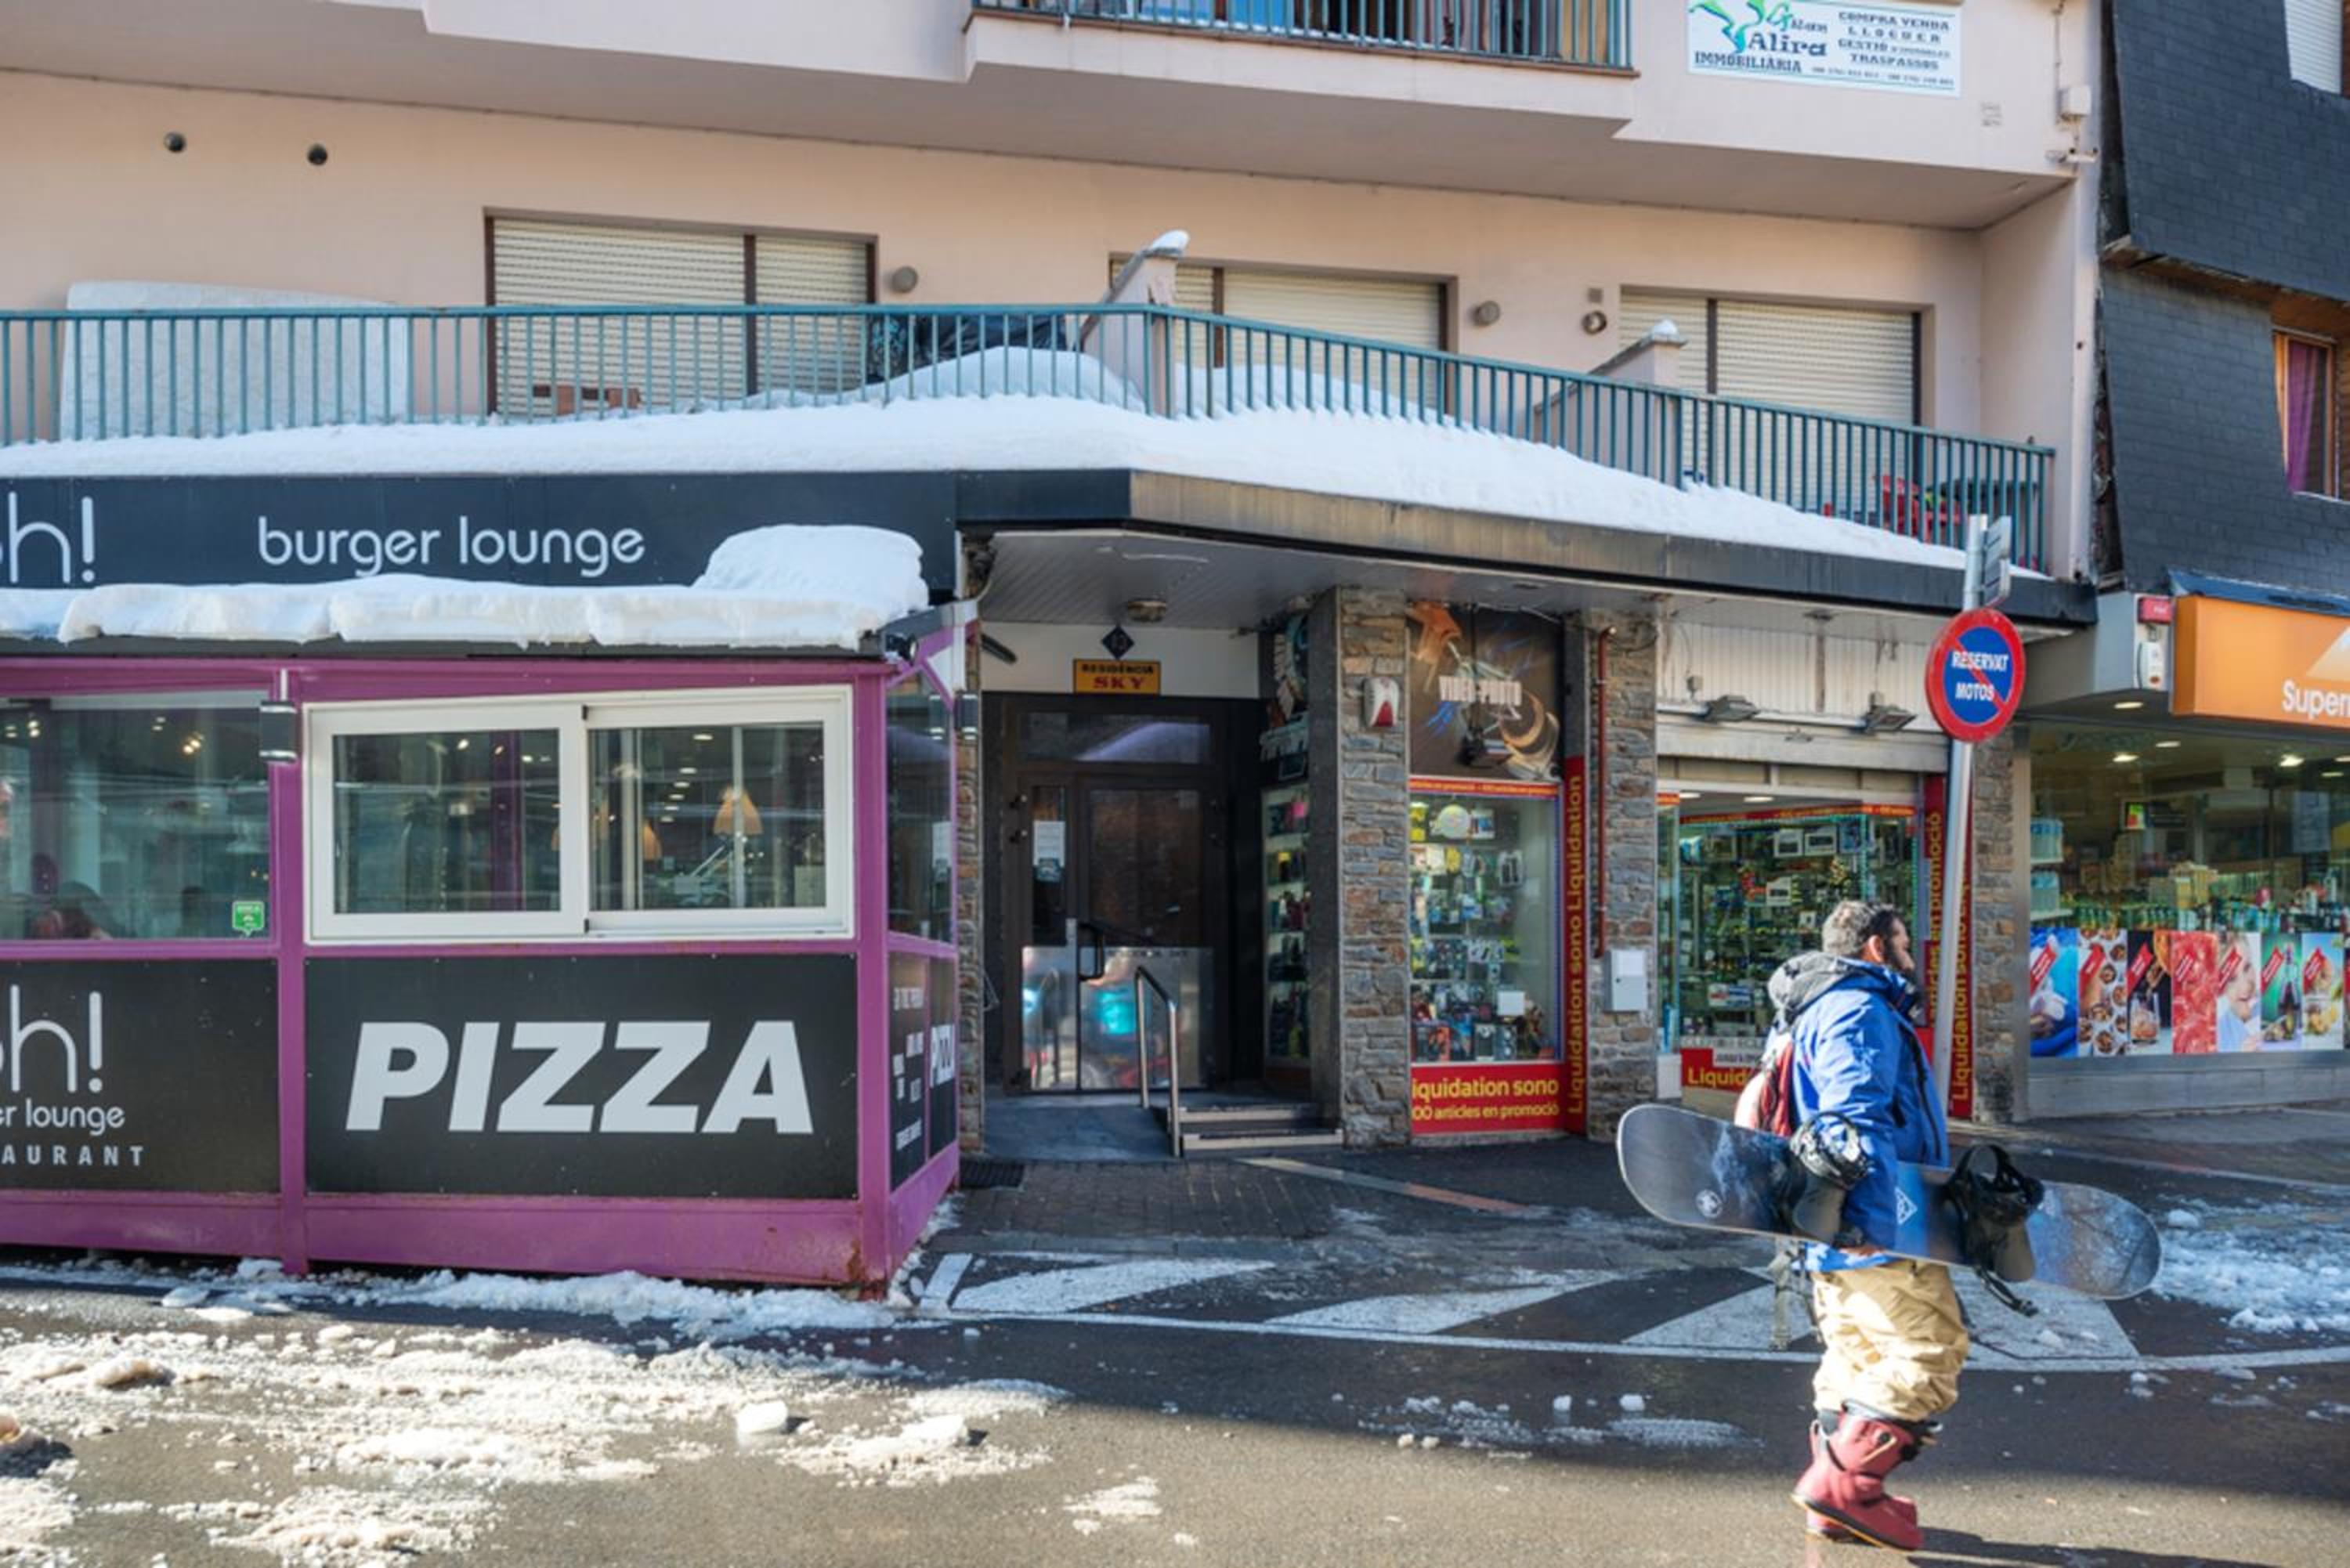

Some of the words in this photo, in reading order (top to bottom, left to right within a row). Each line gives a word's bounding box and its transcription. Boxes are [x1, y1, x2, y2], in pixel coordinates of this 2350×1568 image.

[1838, 12, 1897, 26] COMPRA
[1901, 17, 1950, 31] VENDA
[1748, 33, 1828, 56] Alira
[1850, 52, 1940, 70] TRASPASSOS
[0, 491, 95, 583] h!
[258, 515, 441, 577] burger
[459, 515, 645, 577] lounge
[1952, 651, 2009, 672] RESERVAT
[1093, 676, 1144, 690] SKY
[1955, 681, 1994, 702] MOTOS
[2280, 678, 2350, 721] Super
[1567, 775, 1585, 911] Liquidation
[1570, 916, 1582, 975] sono
[0, 985, 103, 1093] h!
[1568, 977, 1585, 1114] Liquidation
[1953, 975, 1972, 1101] Liquidation
[345, 1021, 814, 1133] PIZZA
[1412, 1076, 1509, 1102] iquidation
[1513, 1079, 1559, 1096] sono
[1687, 1065, 1752, 1088] Liquid
[25, 1098, 125, 1136] lounge
[1483, 1106, 1498, 1118] en
